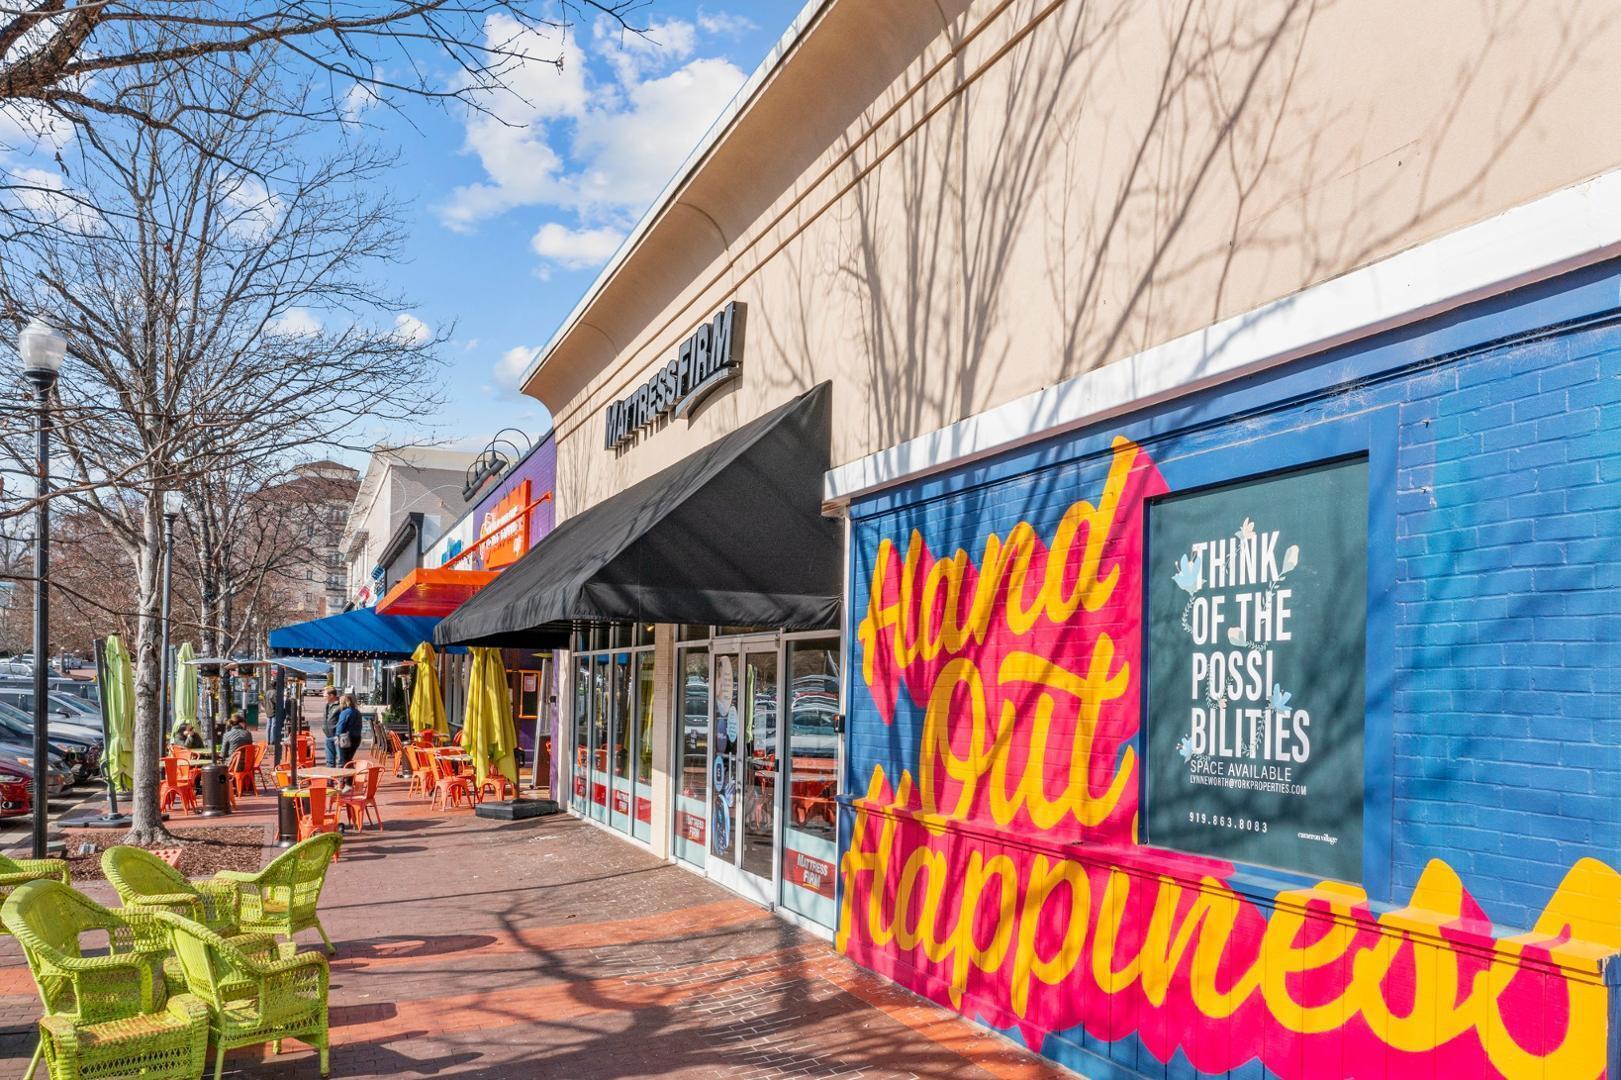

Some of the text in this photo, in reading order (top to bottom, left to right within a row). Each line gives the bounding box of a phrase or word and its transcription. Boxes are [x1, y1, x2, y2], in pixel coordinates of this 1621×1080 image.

[858, 435, 1139, 687] Hand
[1191, 531, 1280, 590] THINK
[1192, 589, 1292, 645] OF THE
[1192, 650, 1273, 701] POSSI
[920, 632, 1135, 836] Out
[1191, 707, 1310, 763] BILITIES
[1190, 760, 1292, 782] SPACE AVAILABLE
[1190, 775, 1307, 796] LYNNEWORTH@YORKPROPERTIES.COM
[1189, 811, 1268, 833] 919.863.8083
[797, 853, 828, 876] MATTRESS
[803, 869, 821, 889] FIRM
[836, 763, 1621, 1080] Happiness
